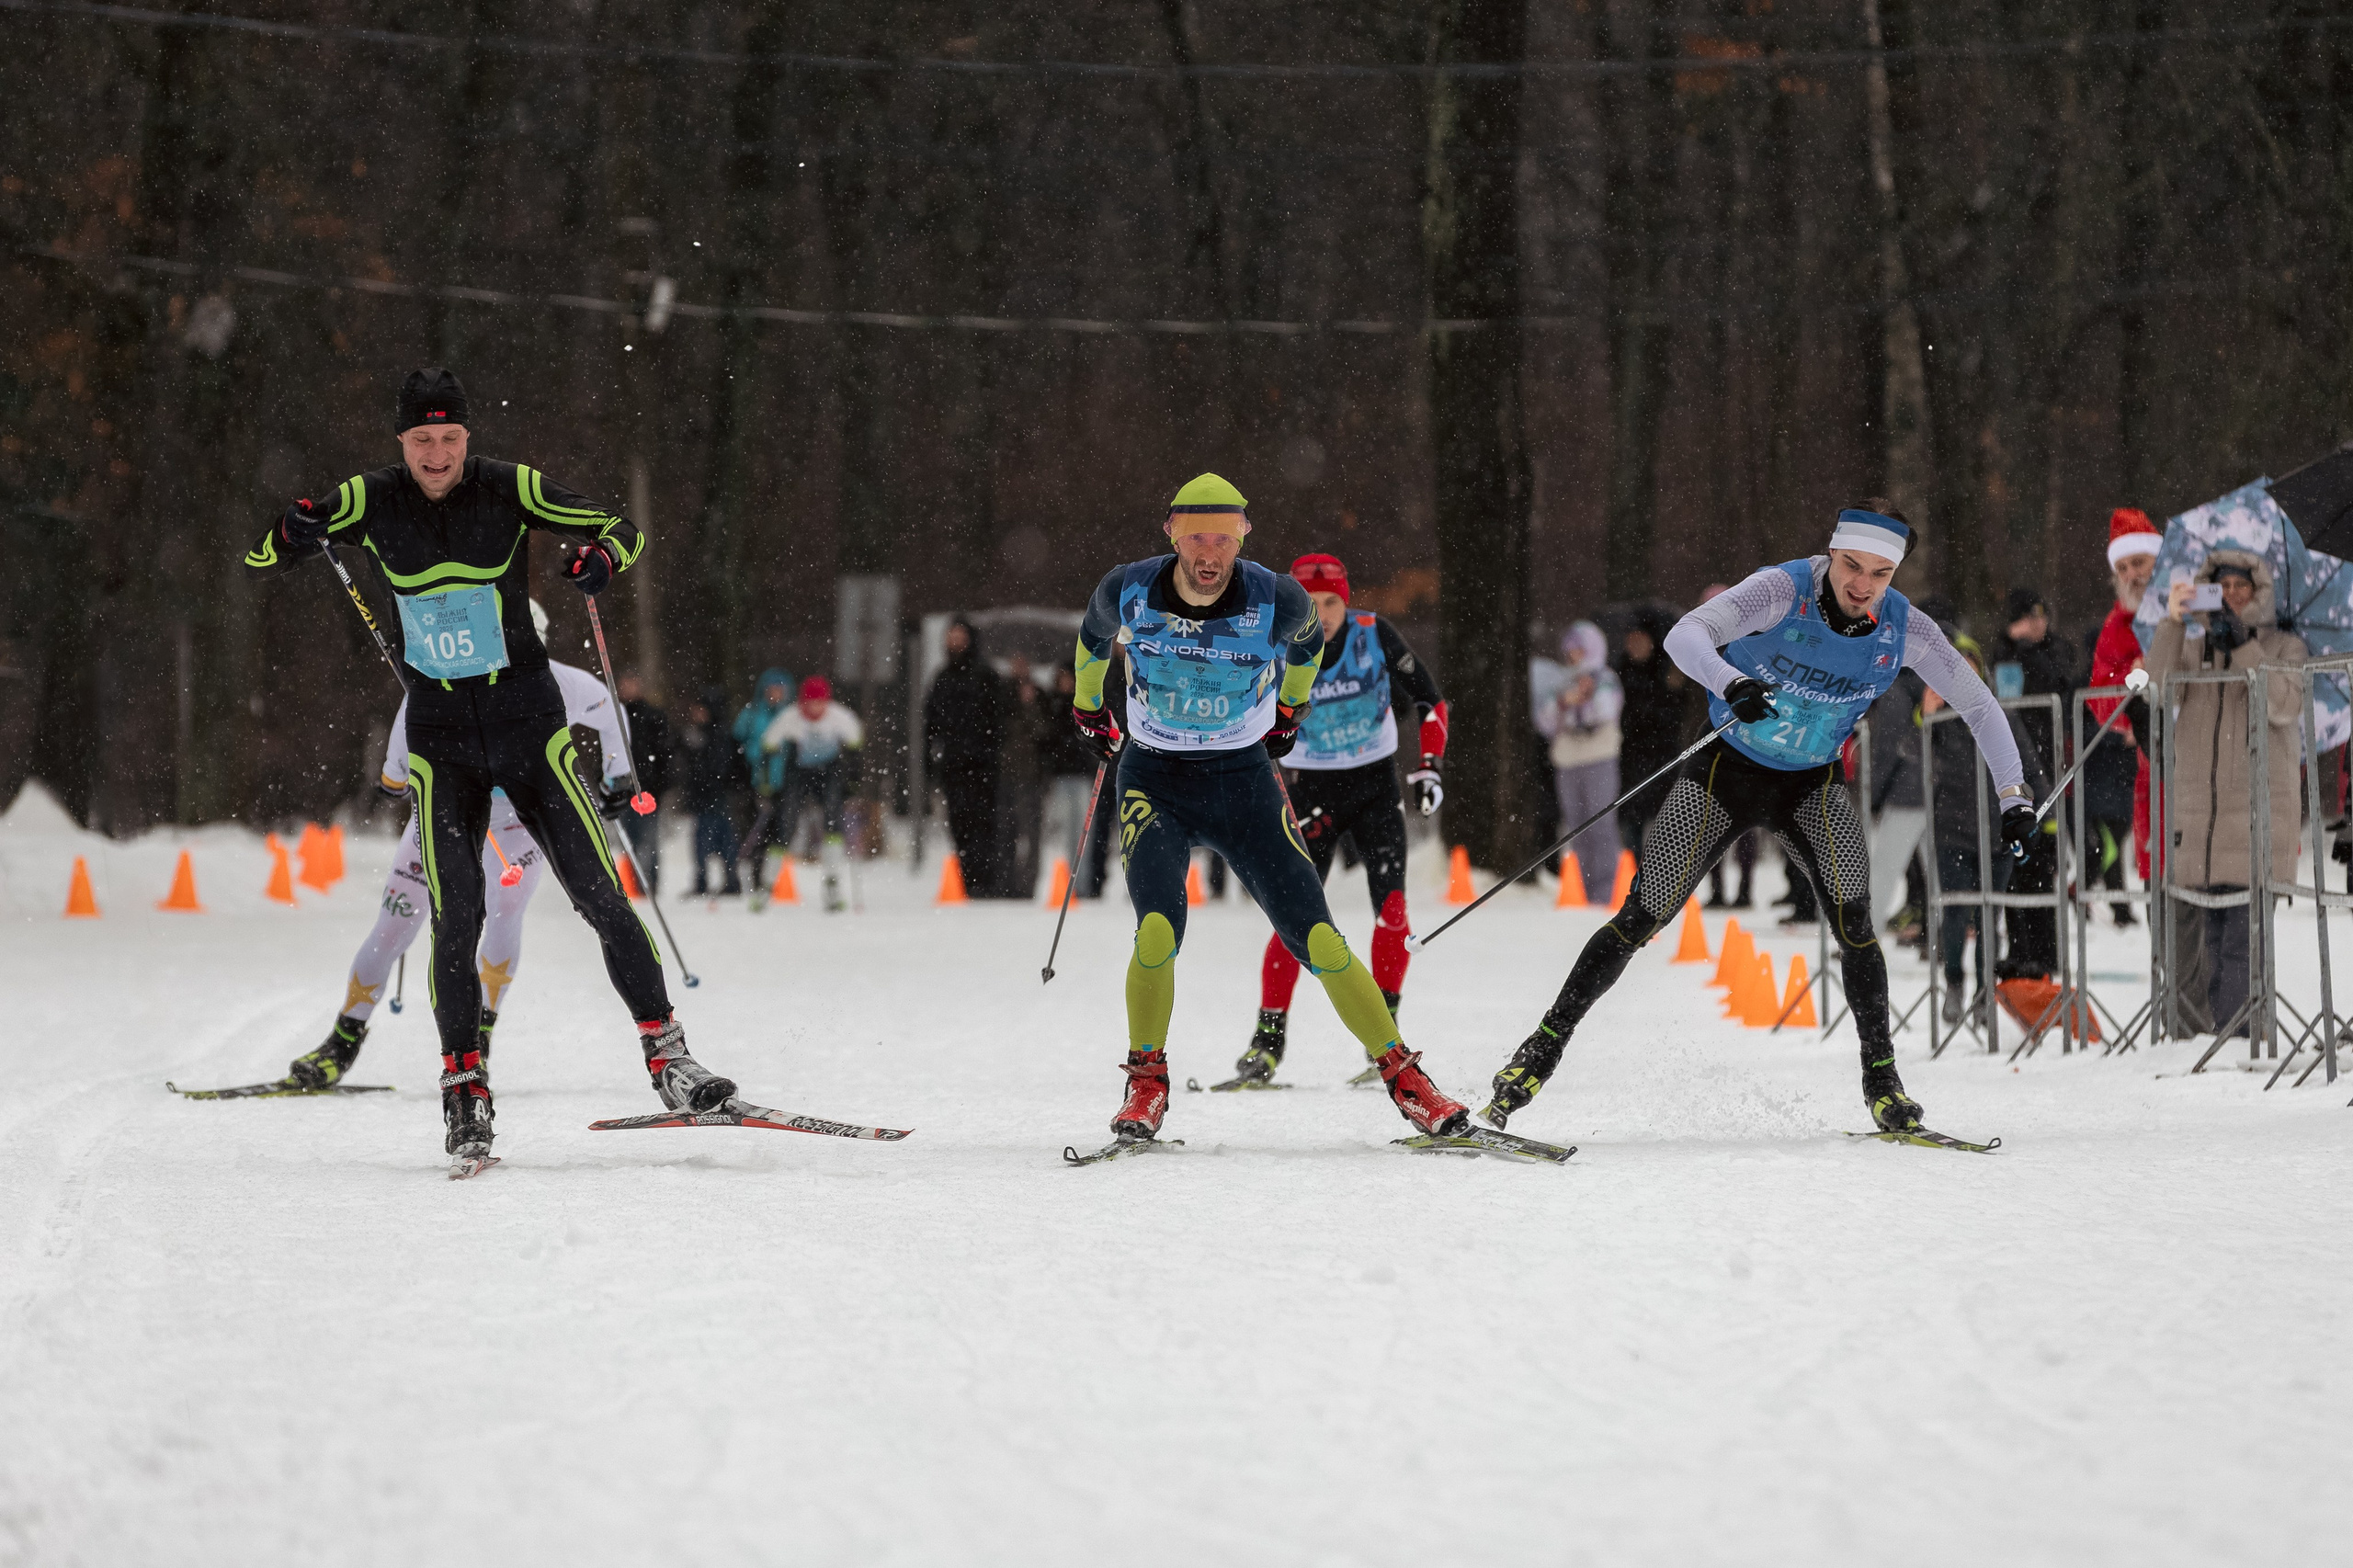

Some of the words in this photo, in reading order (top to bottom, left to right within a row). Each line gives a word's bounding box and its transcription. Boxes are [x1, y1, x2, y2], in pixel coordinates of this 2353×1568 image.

[437, 608, 468, 619] ЛЫЖНЯ
[437, 615, 469, 626] РОССИИ
[1238, 617, 1260, 628] CUP
[424, 629, 475, 660] 105
[1164, 643, 1251, 662] NORDSKI
[1189, 685, 1222, 694] РОССИИ
[1190, 678, 1222, 687] ЛЫЖНЯ
[1772, 722, 1807, 749] 21
[654, 1028, 683, 1048] ROSSIG
[441, 1070, 480, 1087] OSSIGNOL
[1404, 1100, 1430, 1119] alpina
[696, 1114, 734, 1126] ROSSIGNOL
[787, 1116, 866, 1138] ROSSIGNOL
